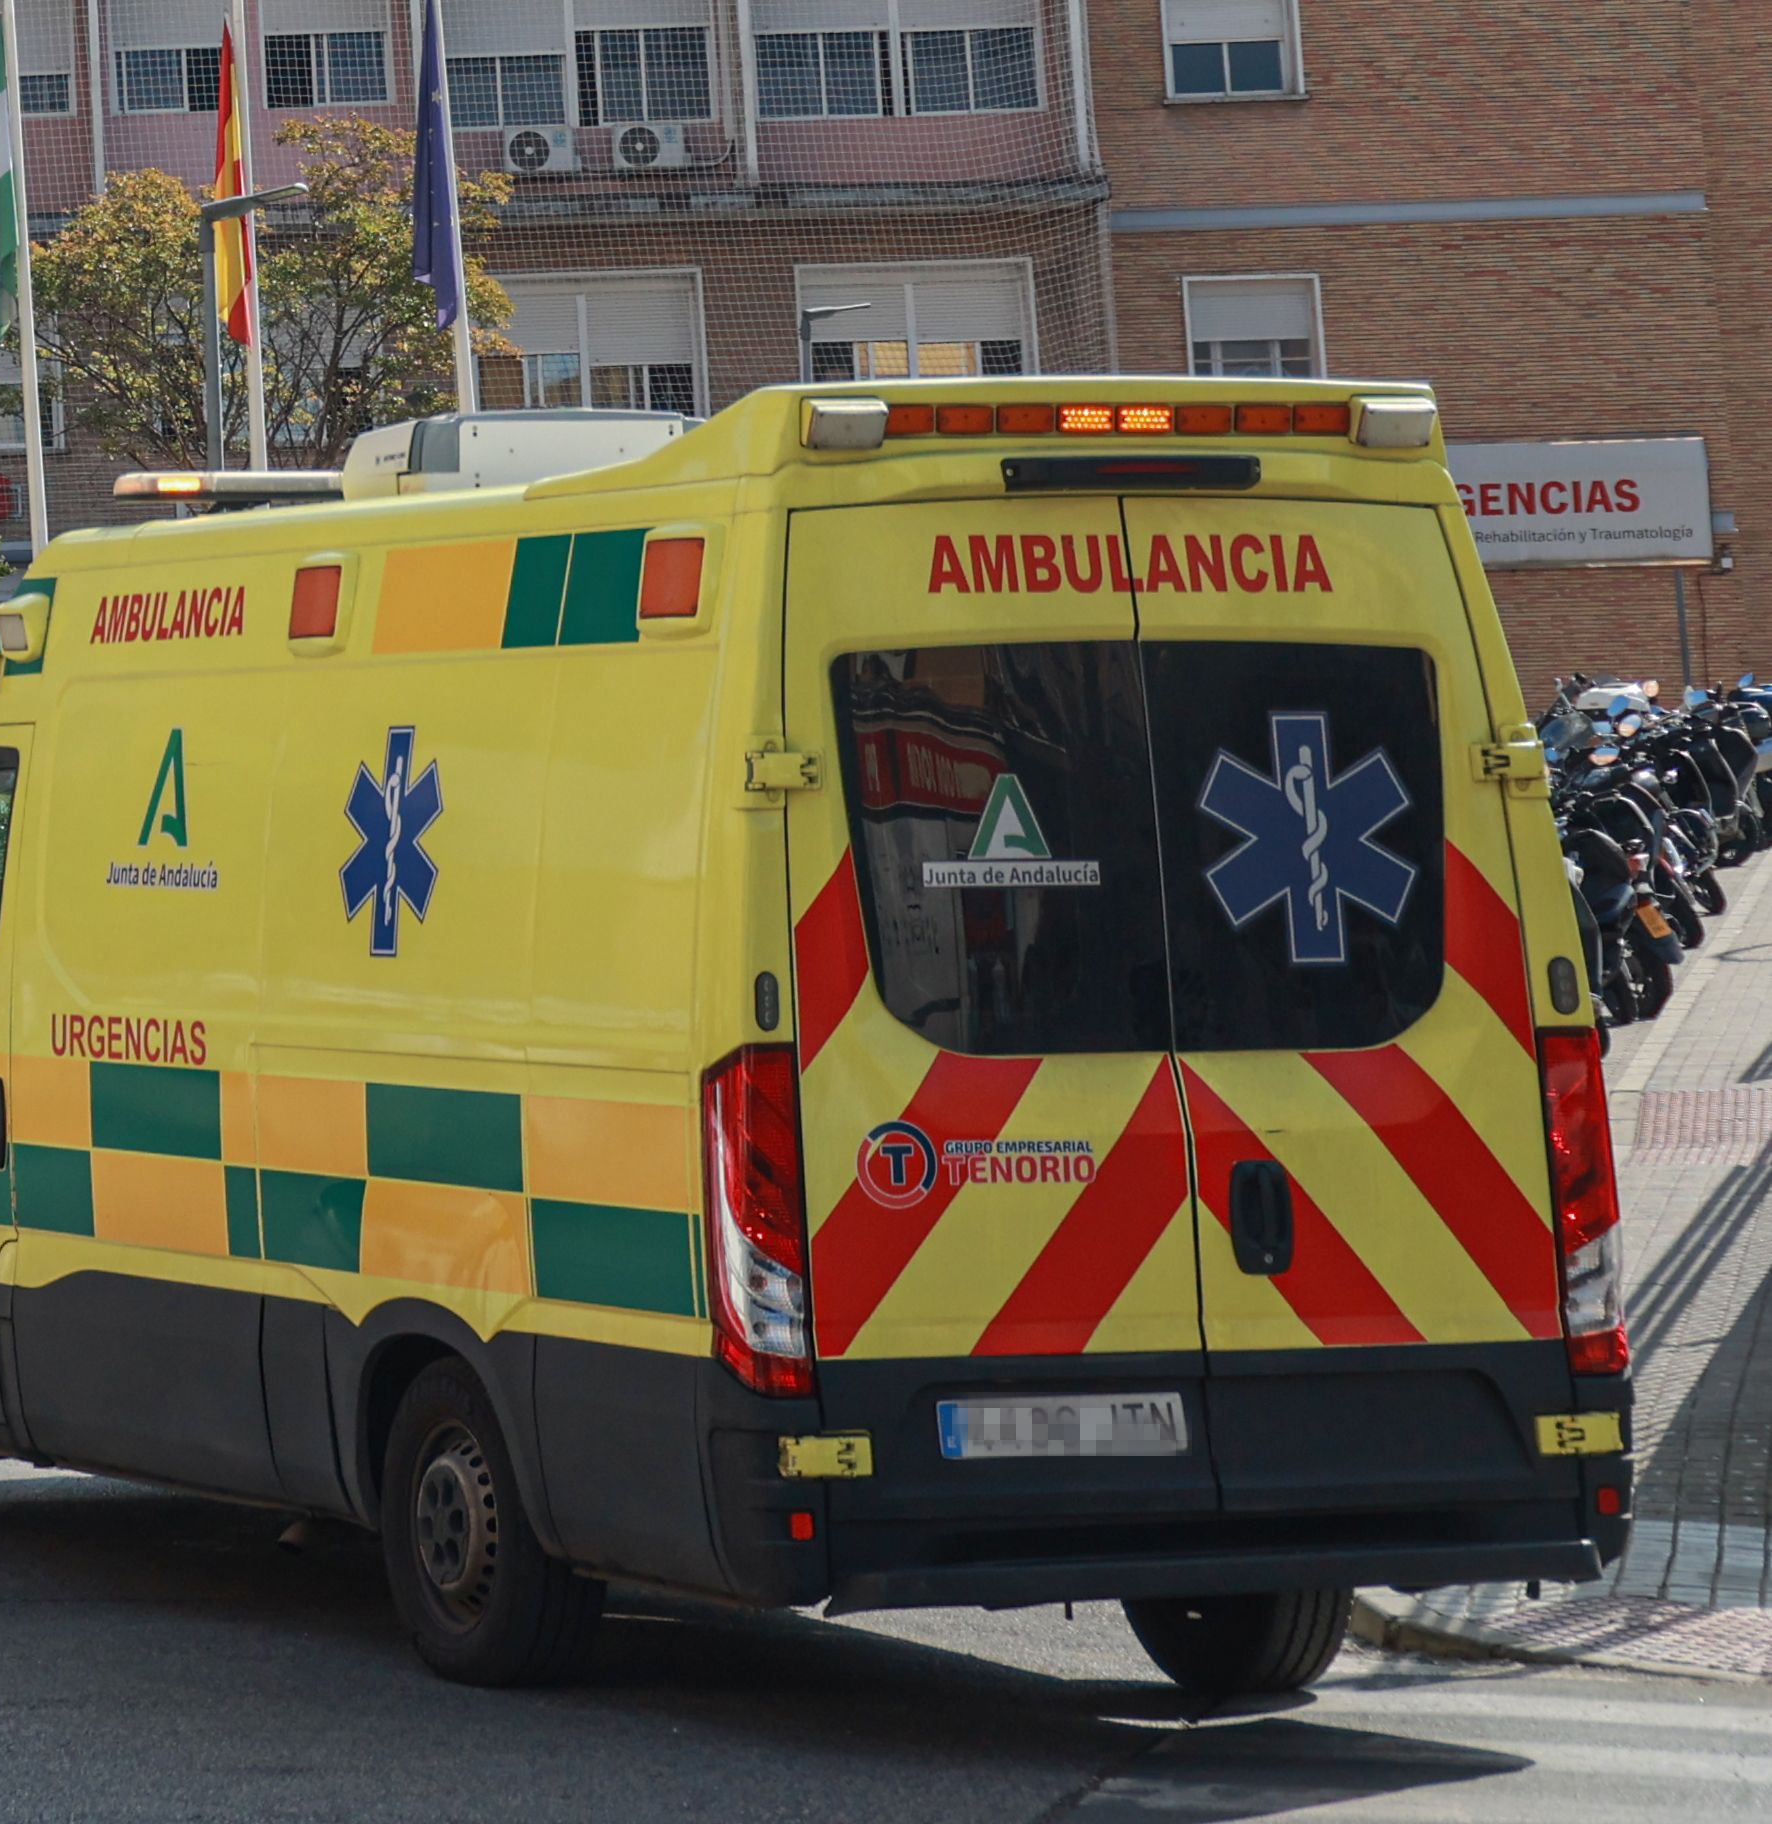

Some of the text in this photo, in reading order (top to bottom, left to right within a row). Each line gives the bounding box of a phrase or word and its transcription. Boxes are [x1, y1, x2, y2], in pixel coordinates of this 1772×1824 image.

[1455, 479, 1641, 517] GENCIAS
[1475, 524, 1694, 544] Rehabilitación y Traumatología
[928, 532, 1334, 594] AMBULANCIA
[89, 585, 245, 645] AMBULANCIA
[106, 859, 218, 889] Junta de Andalucía
[924, 863, 1099, 885] Junta de Andalucía
[51, 1013, 207, 1066] URGENCIAS
[944, 1139, 1094, 1154] GRUPO EMPRESARIAL
[942, 1154, 1097, 1186] TENORIO
